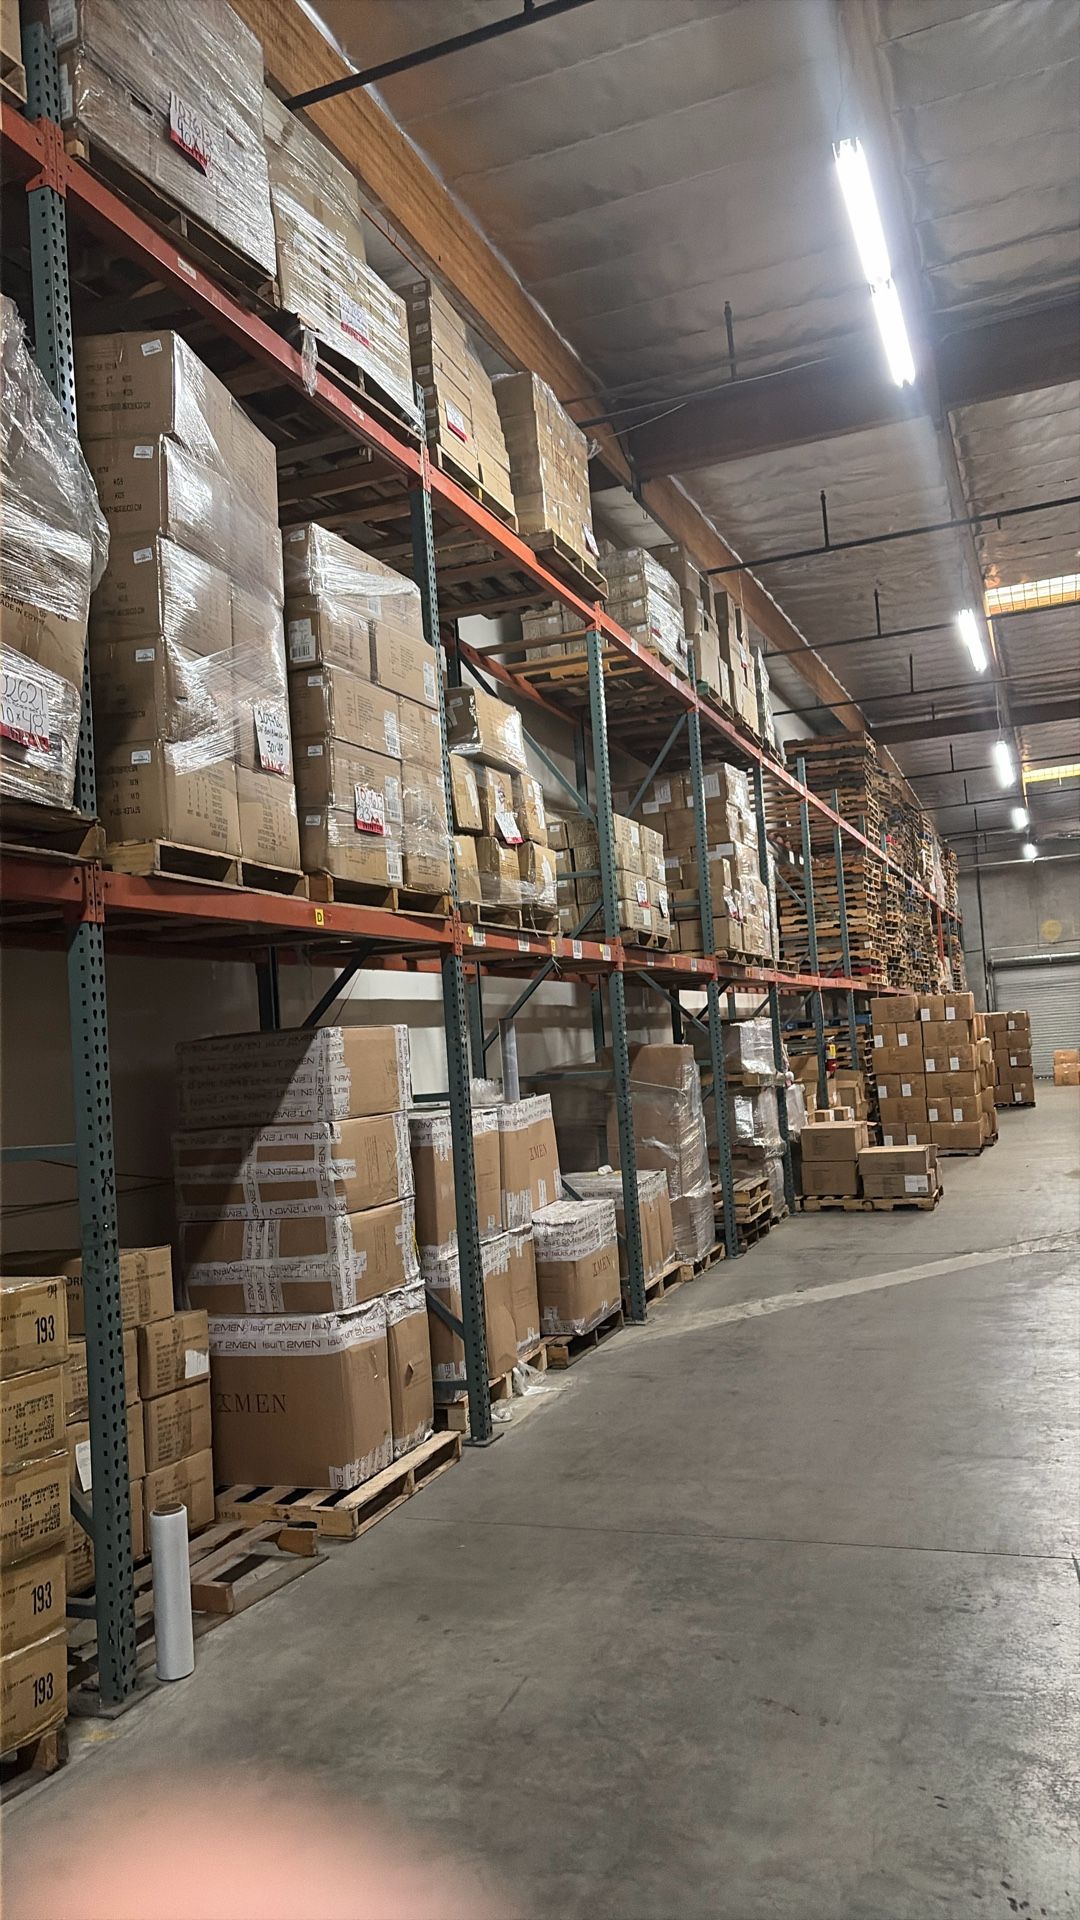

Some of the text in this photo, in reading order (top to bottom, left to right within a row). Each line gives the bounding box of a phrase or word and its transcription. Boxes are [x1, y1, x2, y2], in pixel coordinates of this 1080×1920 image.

[316, 911, 323, 923] D
[35, 1314, 55, 1345] 193
[31, 1581, 52, 1615] 193
[32, 1671, 54, 1708] 193
